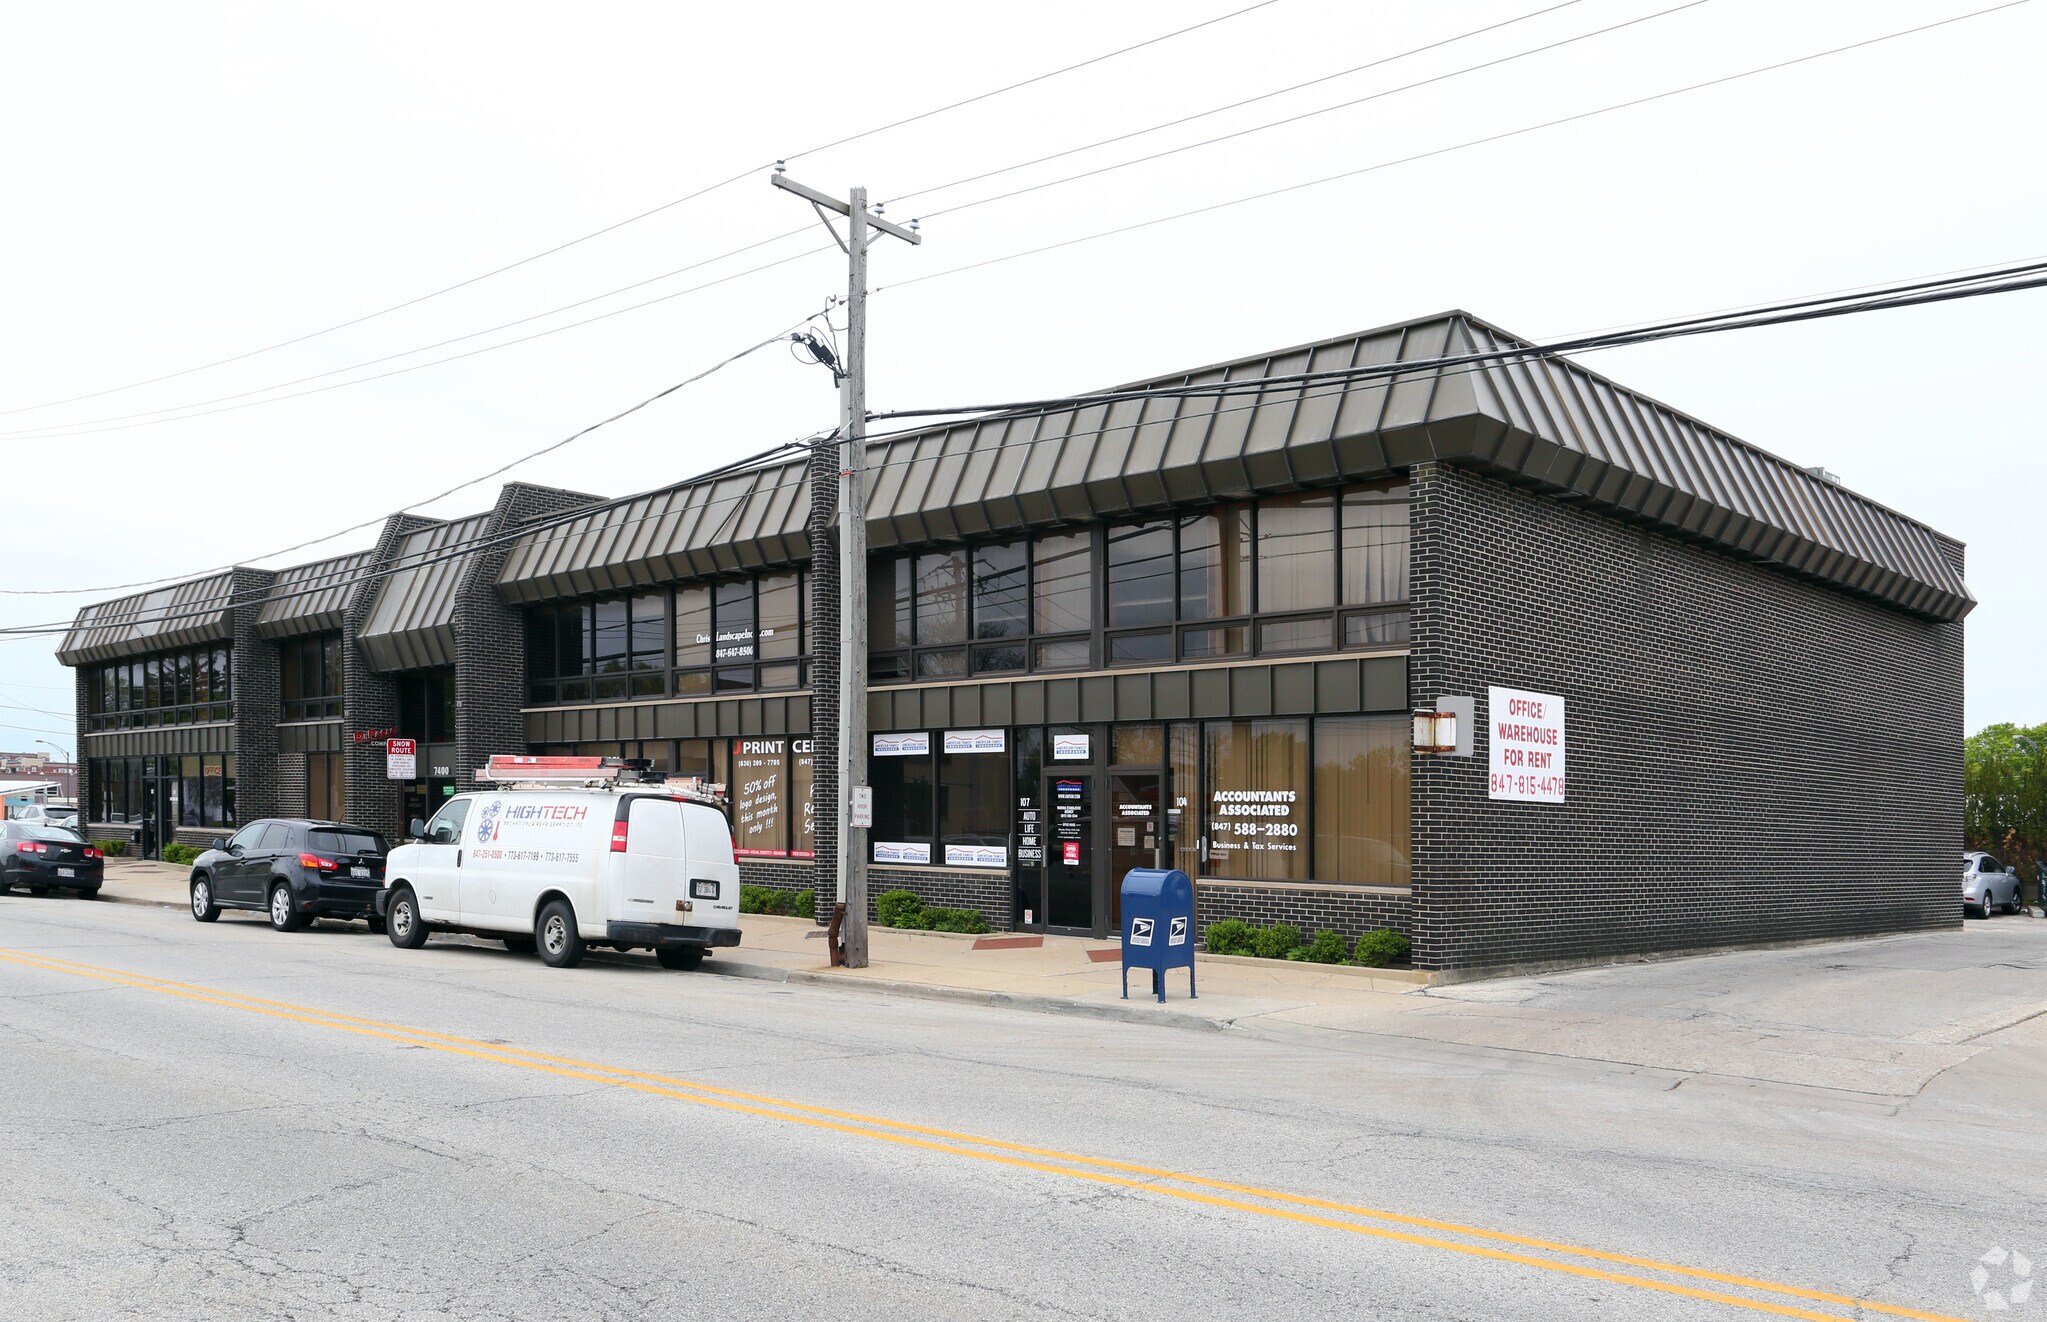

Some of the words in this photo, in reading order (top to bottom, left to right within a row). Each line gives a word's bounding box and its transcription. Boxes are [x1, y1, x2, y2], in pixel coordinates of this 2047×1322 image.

[696, 633, 711, 644] Chris
[1498, 722, 1558, 745] WAREHOUSE
[792, 740, 814, 754] CE
[1504, 748, 1524, 767] FOR
[1528, 750, 1552, 769] RENT
[433, 766, 450, 775] 7400
[743, 779, 762, 796] 50%
[763, 774, 777, 790] off
[1176, 796, 1188, 807] 104
[1213, 790, 1296, 802] ACCOUNTANTS
[739, 800, 753, 811] logo
[1020, 797, 1030, 807] 107
[505, 805, 588, 820] HIGHTECH
[740, 812, 753, 824] this
[756, 803, 778, 819] month
[1219, 804, 1290, 816] ASSOCIATED
[1023, 811, 1036, 821] AUTO
[749, 821, 763, 834] only
[1024, 823, 1035, 834] LIFE
[1211, 821, 1231, 831] (847)
[1022, 836, 1037, 846] HOME
[1212, 840, 1241, 849] Business
[1243, 841, 1249, 850] &
[1251, 841, 1264, 850] Tax
[1267, 842, 1297, 851] Services
[1018, 848, 1042, 859] BUSINESS
